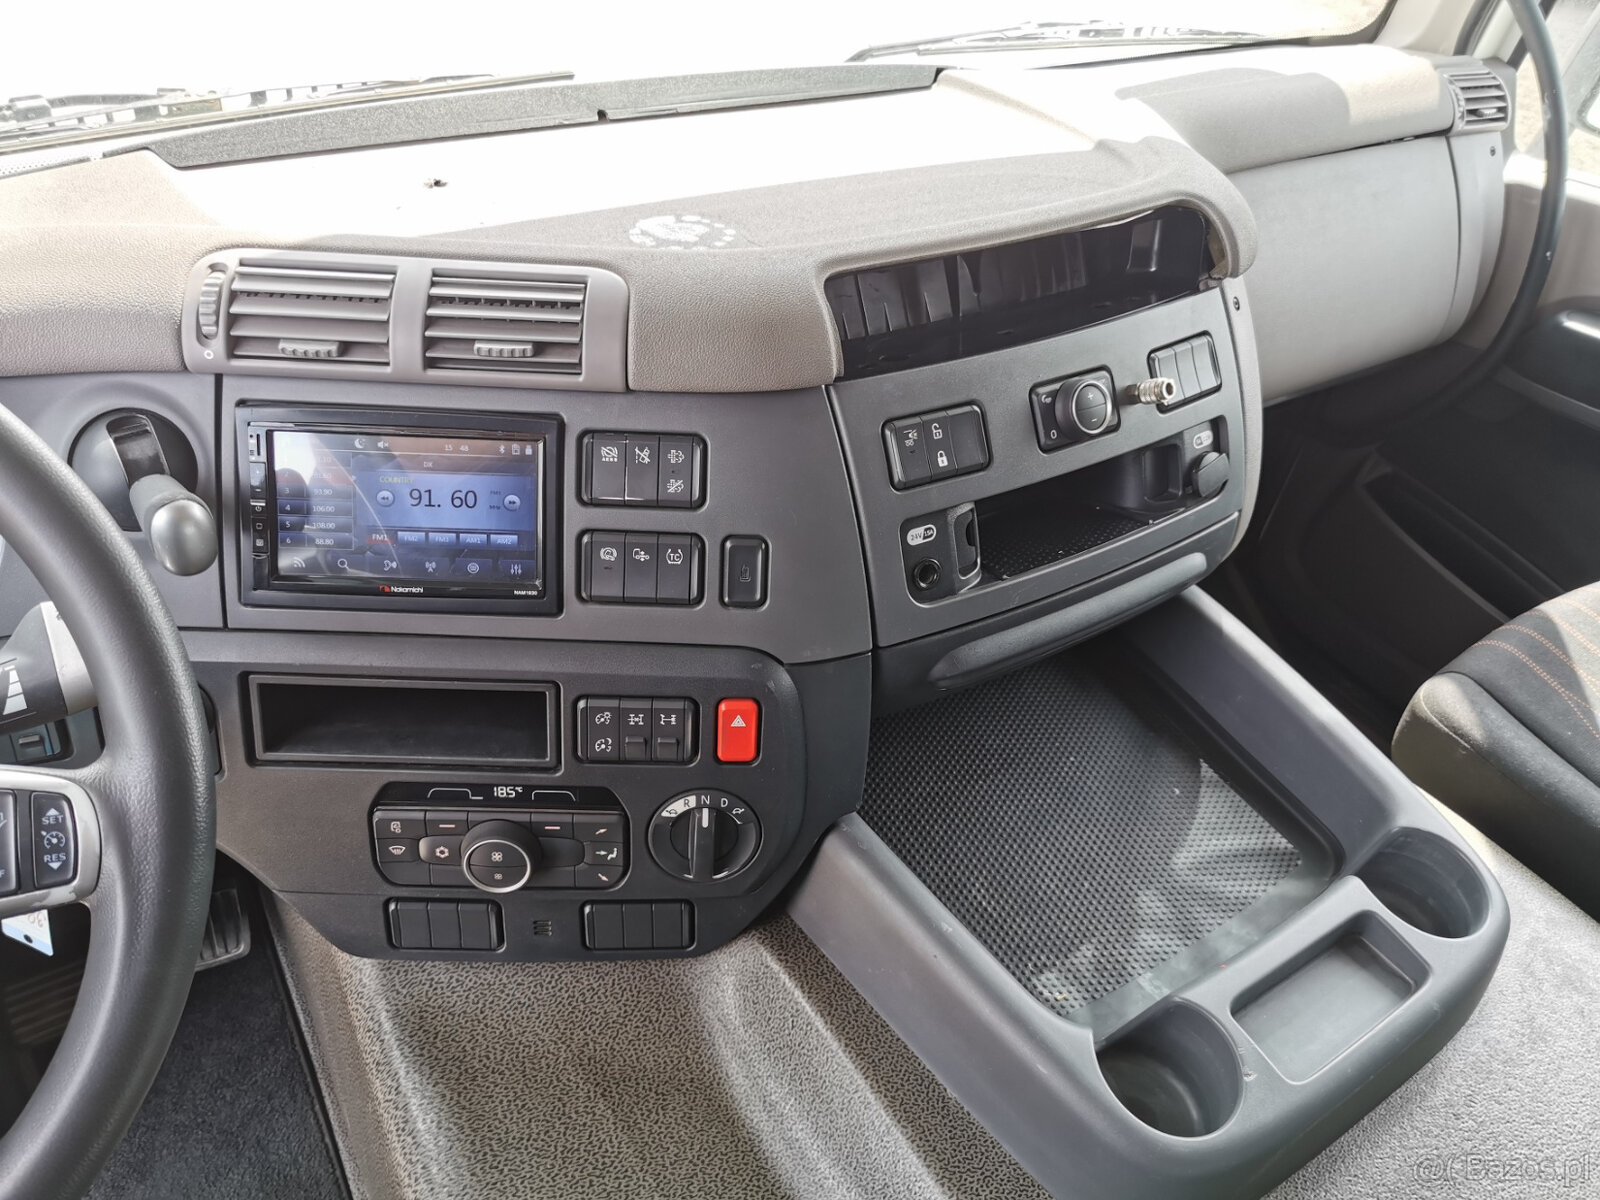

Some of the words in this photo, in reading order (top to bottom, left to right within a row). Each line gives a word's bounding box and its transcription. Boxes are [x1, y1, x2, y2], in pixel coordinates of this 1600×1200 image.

[371, 533, 389, 541] FM1
[465, 536, 481, 544] AM1
[496, 537, 512, 545] AM2
[669, 553, 680, 561] TC
[390, 585, 424, 594] Nakamichi
[683, 798, 691, 807] R
[700, 794, 710, 805] N
[720, 797, 729, 808] D
[41, 814, 64, 825] SET
[43, 852, 67, 863] RES
